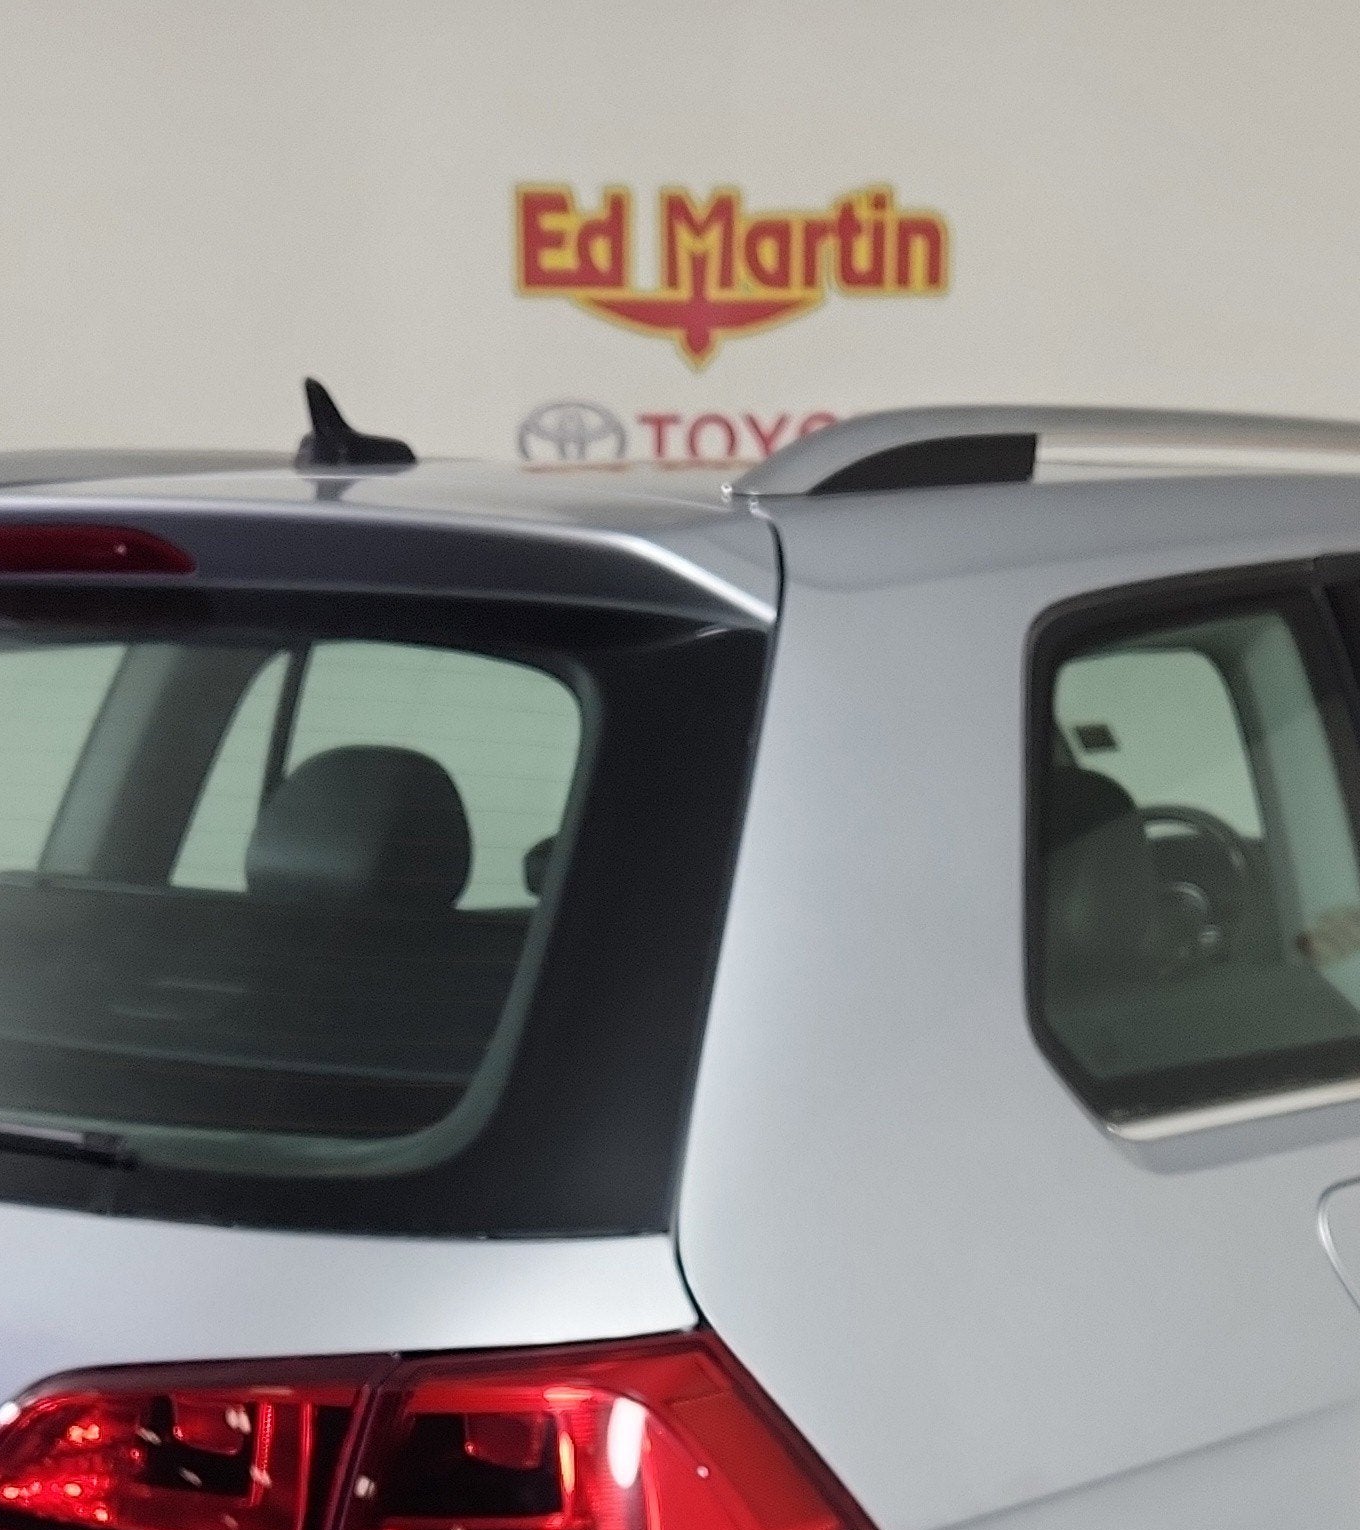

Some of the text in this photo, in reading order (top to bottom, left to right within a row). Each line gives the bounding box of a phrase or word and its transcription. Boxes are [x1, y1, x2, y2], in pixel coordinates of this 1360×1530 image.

[515, 184, 951, 297] Ed Martin
[636, 410, 841, 462] TOY
